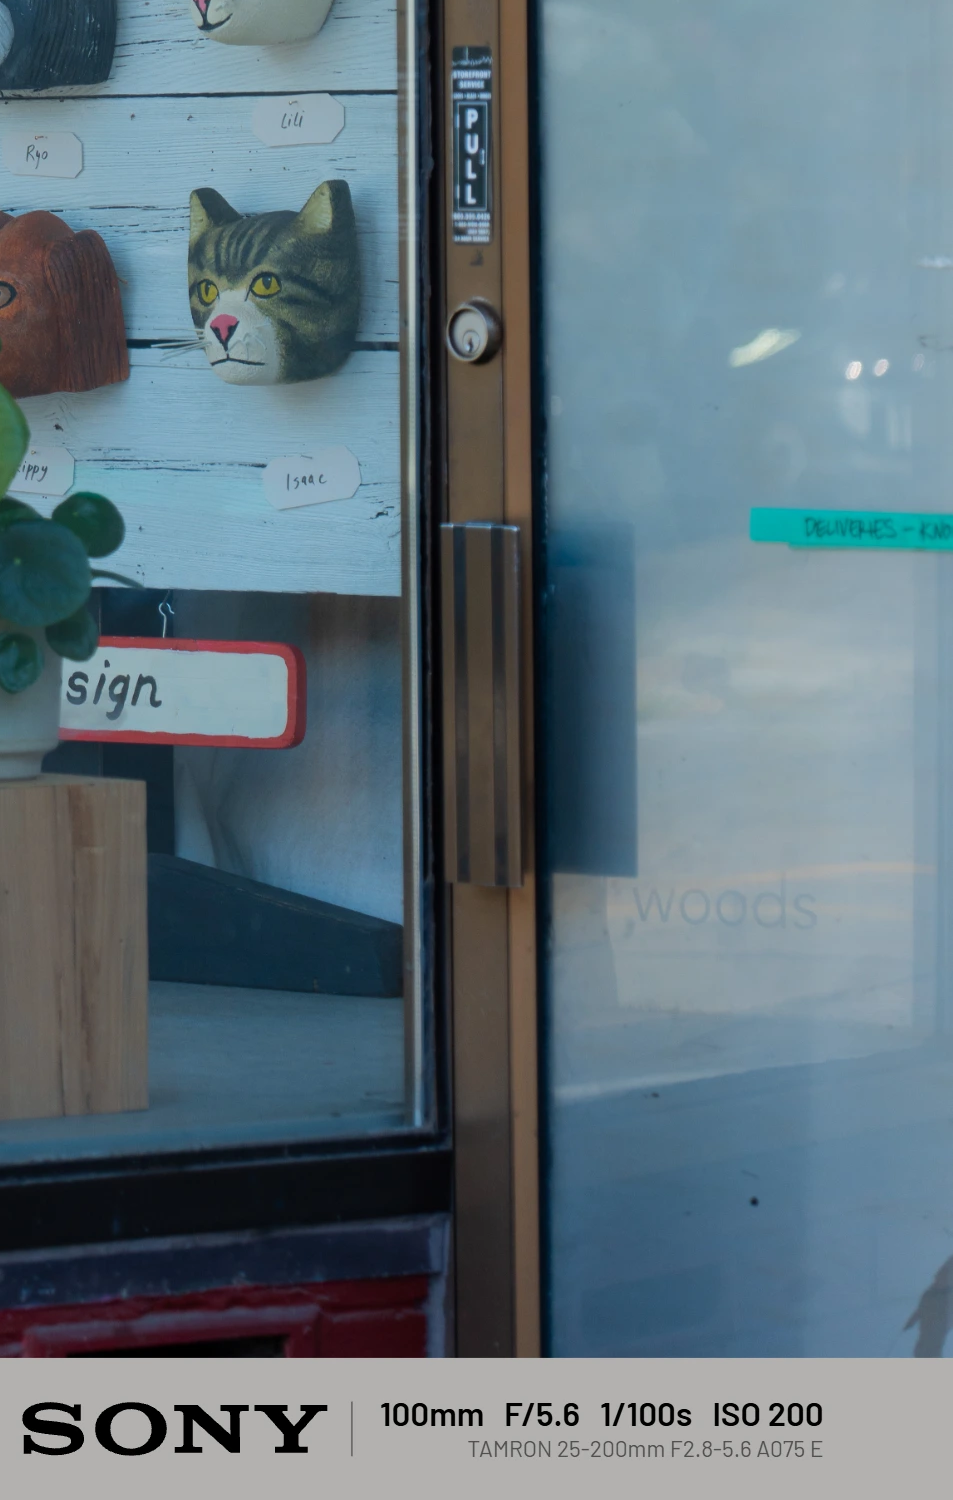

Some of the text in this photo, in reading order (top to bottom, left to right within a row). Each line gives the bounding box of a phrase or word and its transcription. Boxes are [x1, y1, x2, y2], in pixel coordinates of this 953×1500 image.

[26, 144, 48, 170] Ryo
[464, 108, 479, 205] PULL
[286, 473, 328, 491] Isaac
[632, 871, 818, 930] woods
